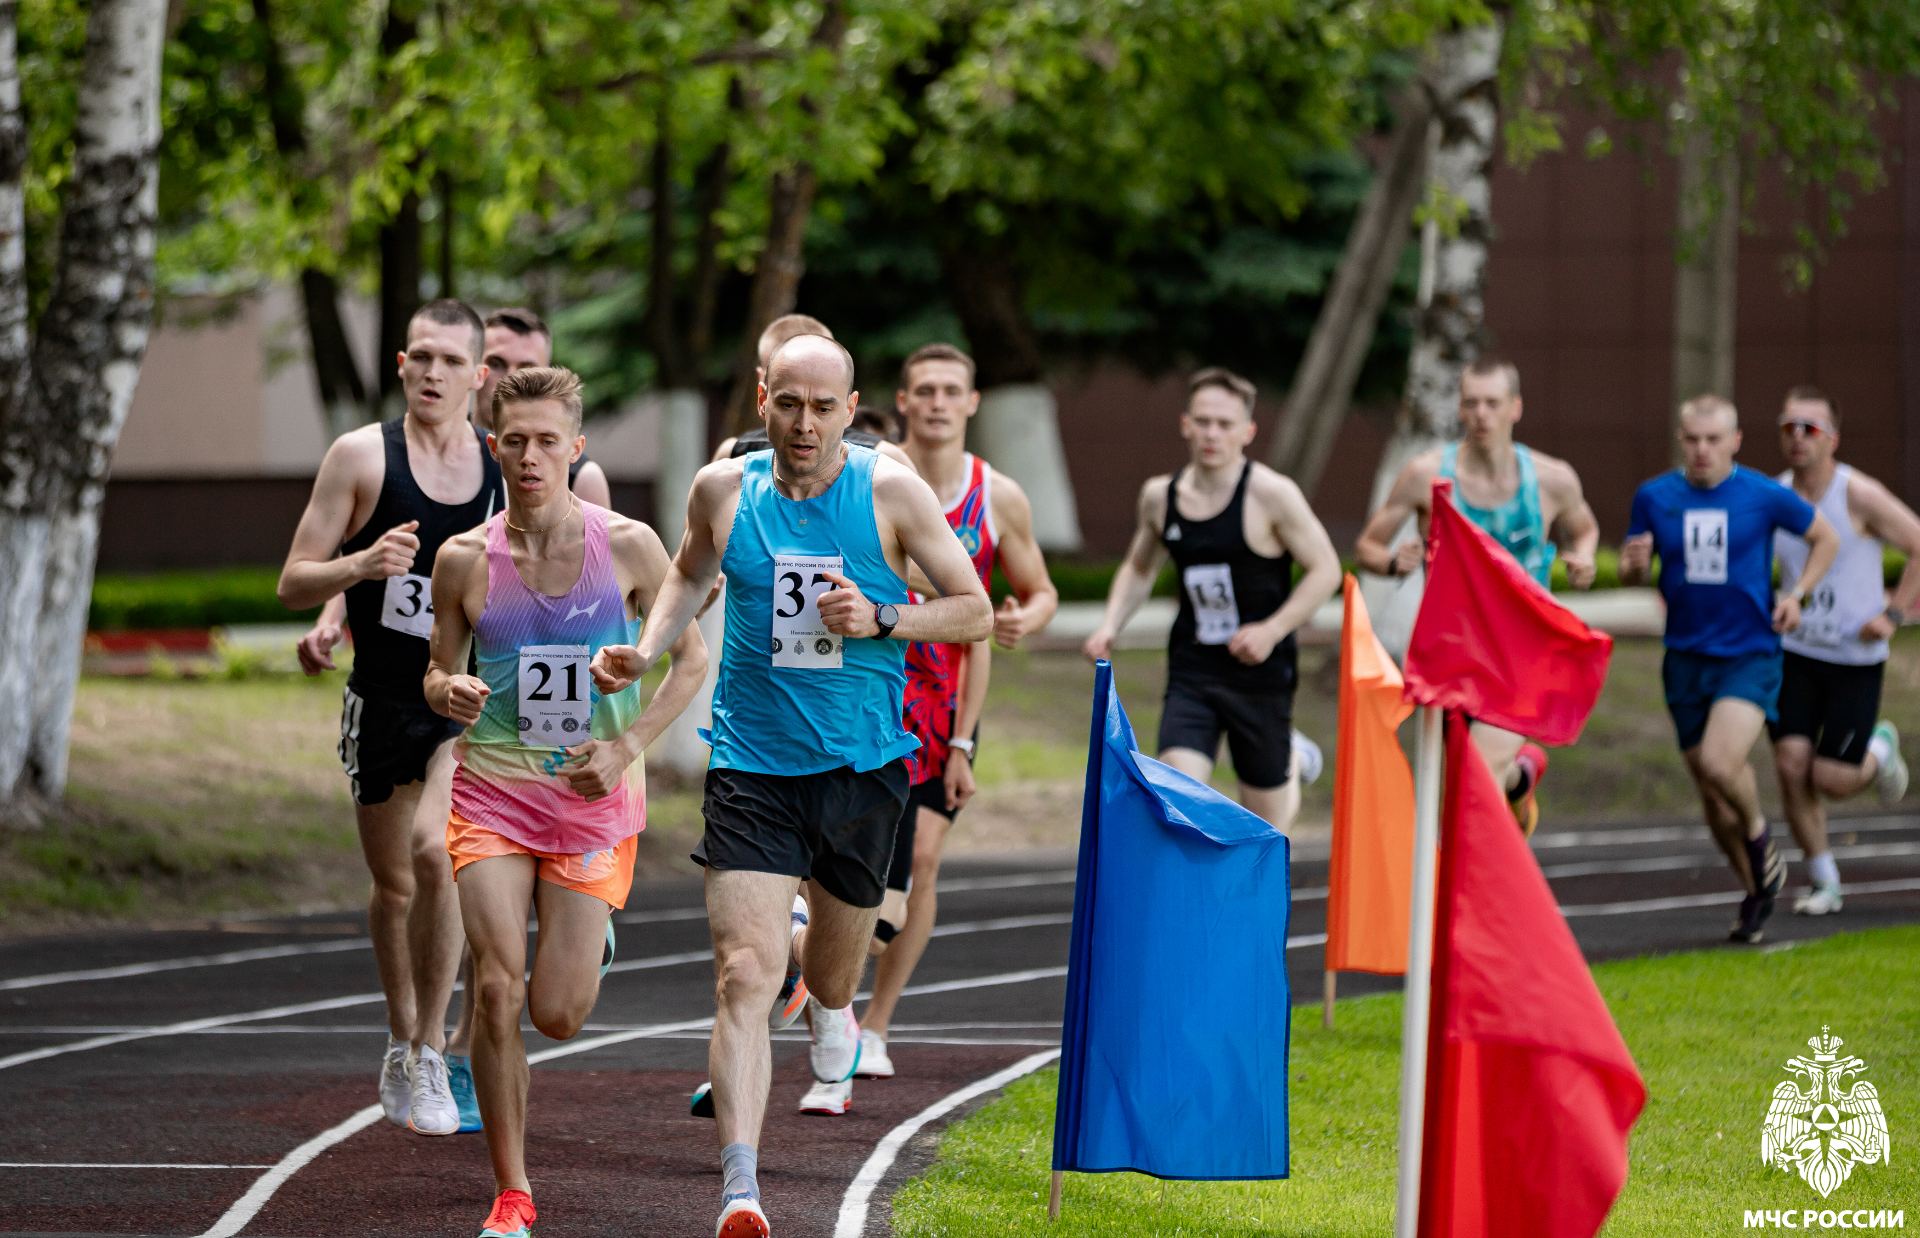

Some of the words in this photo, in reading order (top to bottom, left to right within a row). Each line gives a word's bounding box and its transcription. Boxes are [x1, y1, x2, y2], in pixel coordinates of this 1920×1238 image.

[1692, 525, 1724, 552] 14
[395, 579, 434, 617] 3
[1193, 582, 1230, 611] 13
[526, 662, 583, 702] 21
